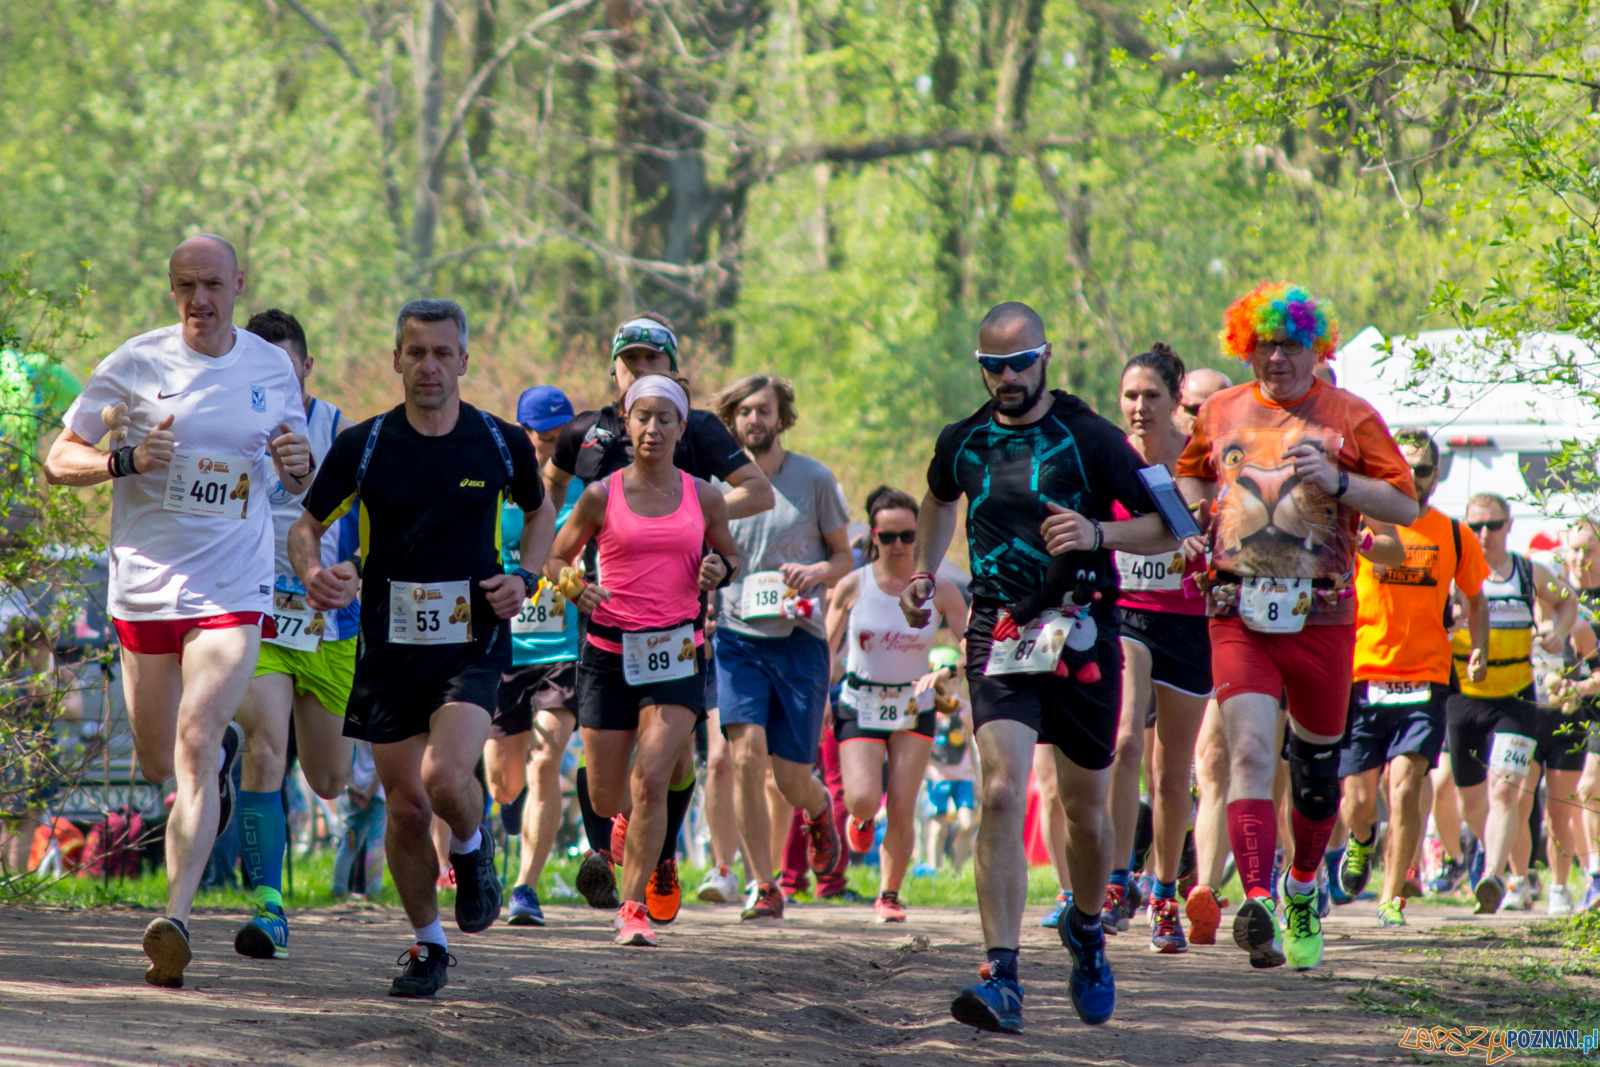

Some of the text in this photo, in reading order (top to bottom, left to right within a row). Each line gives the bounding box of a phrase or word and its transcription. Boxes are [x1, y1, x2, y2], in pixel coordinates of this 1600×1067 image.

[190, 480, 228, 505] 401
[1131, 560, 1165, 580] 400
[756, 590, 778, 606] 138
[416, 610, 441, 632] 53
[1268, 602, 1278, 621] 8
[1014, 639, 1037, 661] 87
[648, 651, 670, 671] 89
[1385, 681, 1412, 694] 355
[880, 705, 897, 721] 28
[1504, 750, 1526, 767] 244
